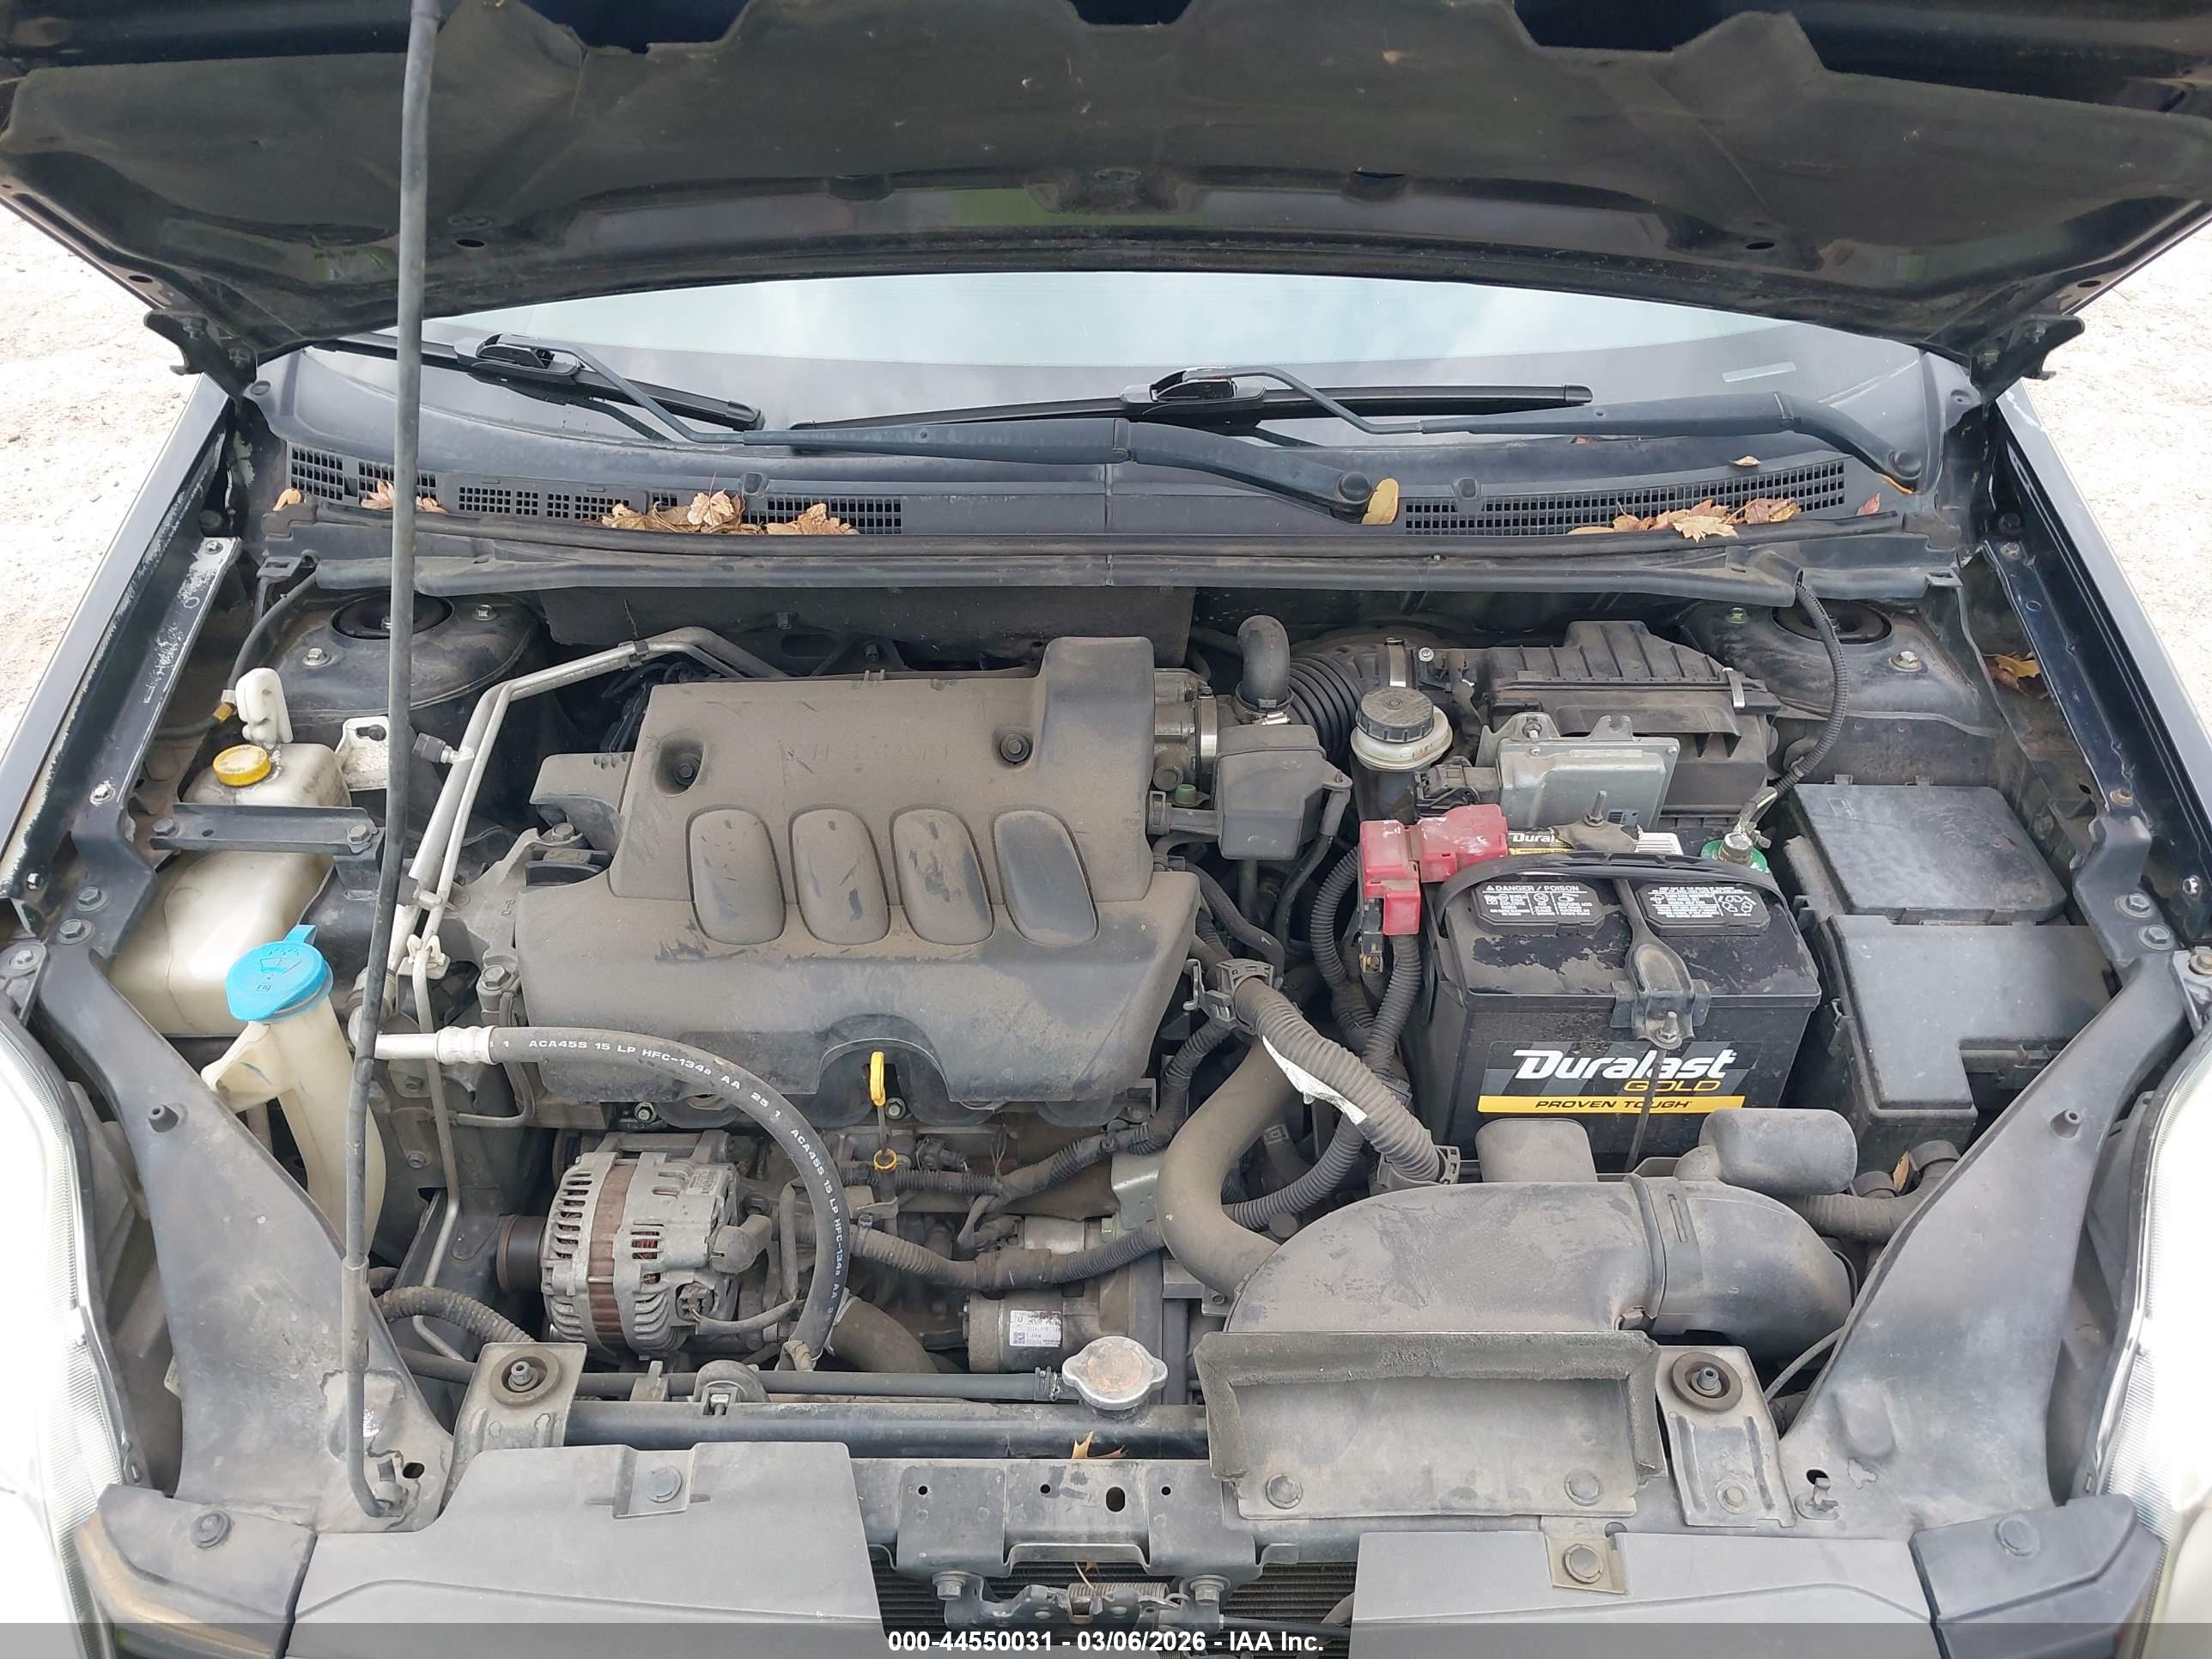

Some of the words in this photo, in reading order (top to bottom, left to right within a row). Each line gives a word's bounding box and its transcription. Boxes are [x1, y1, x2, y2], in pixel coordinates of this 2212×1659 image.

[1512, 1048, 1735, 1079] Duralast
[1623, 1079, 1722, 1092] GOLD
[1535, 1100, 1618, 1109] PROVEN
[529, 1040, 587, 1048] ACA45S
[594, 1042, 611, 1050] 15
[617, 1044, 636, 1053] LP
[641, 1048, 712, 1076] HFC-134a
[720, 1075, 741, 1090] AA
[750, 1091, 769, 1107] 25
[790, 1128, 825, 1176] ACA45S
[823, 1179, 833, 1194] 15
[829, 1197, 839, 1214] LP
